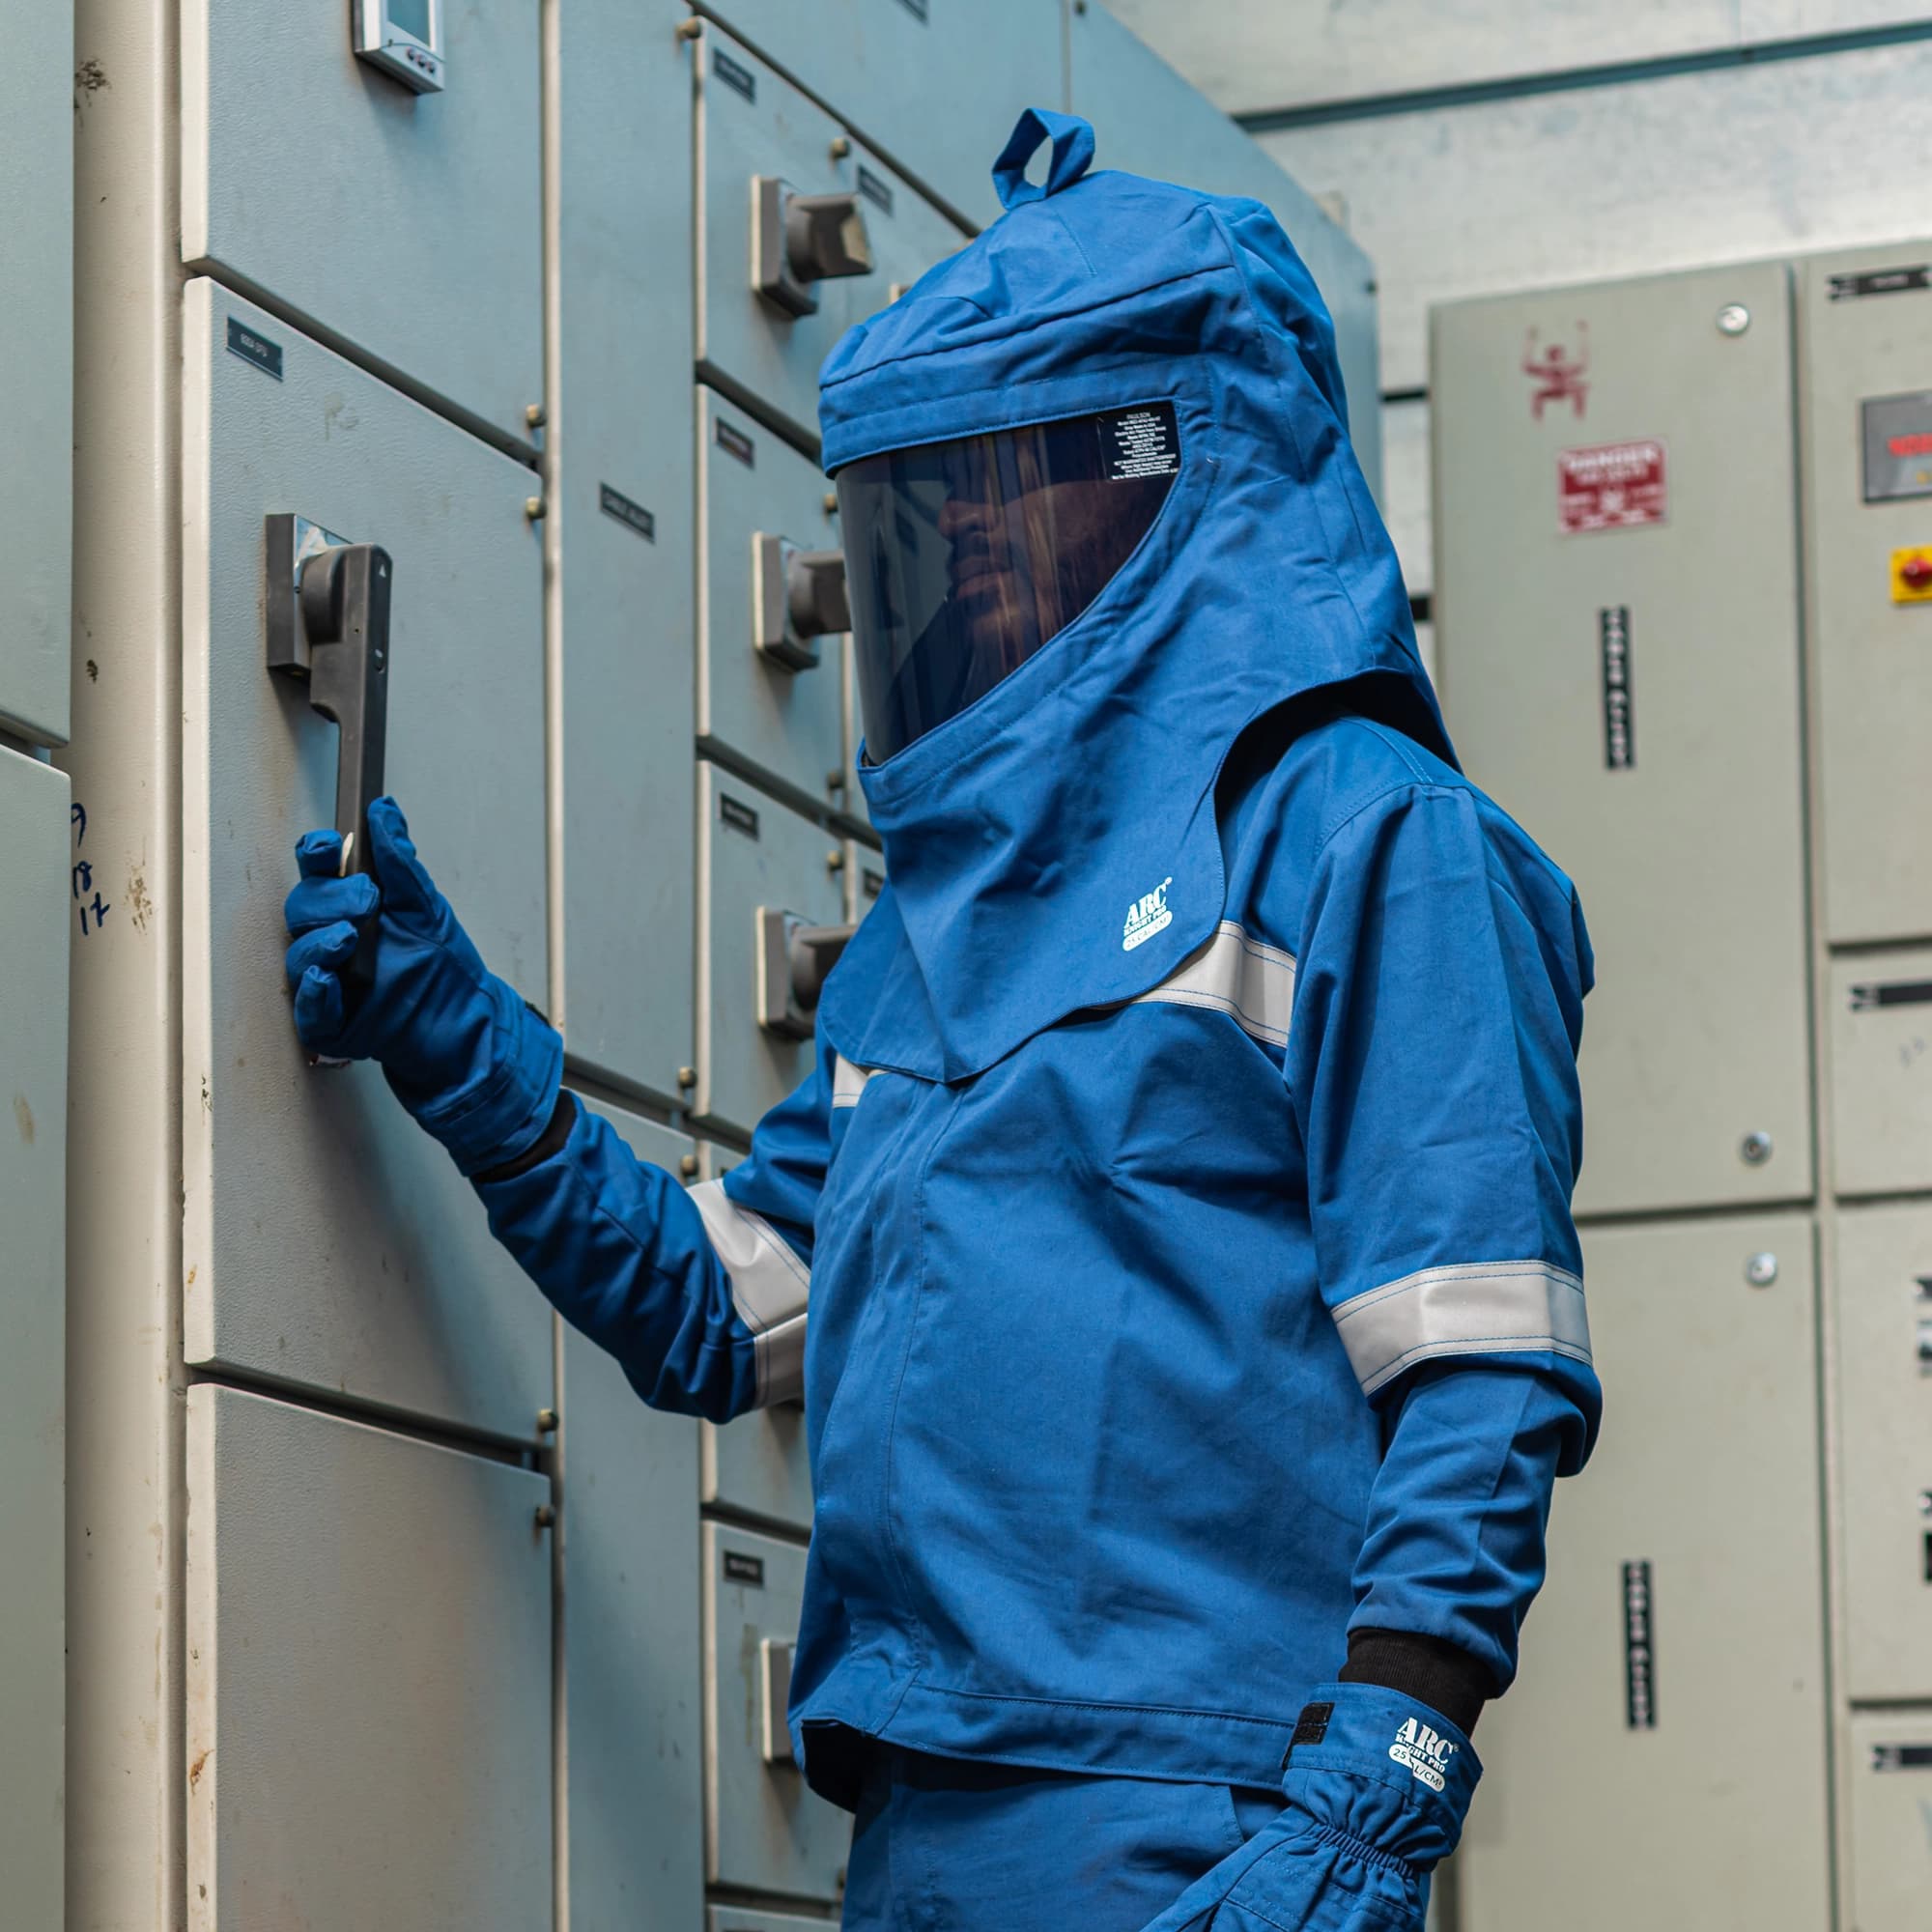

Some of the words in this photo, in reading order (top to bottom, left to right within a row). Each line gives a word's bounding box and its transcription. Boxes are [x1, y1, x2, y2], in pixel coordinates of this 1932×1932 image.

[1393, 1748, 1406, 1759] 25
[1395, 1733, 1428, 1761] KGHT
[1428, 1756, 1445, 1774] PRO
[1397, 1717, 1453, 1764] ARC
